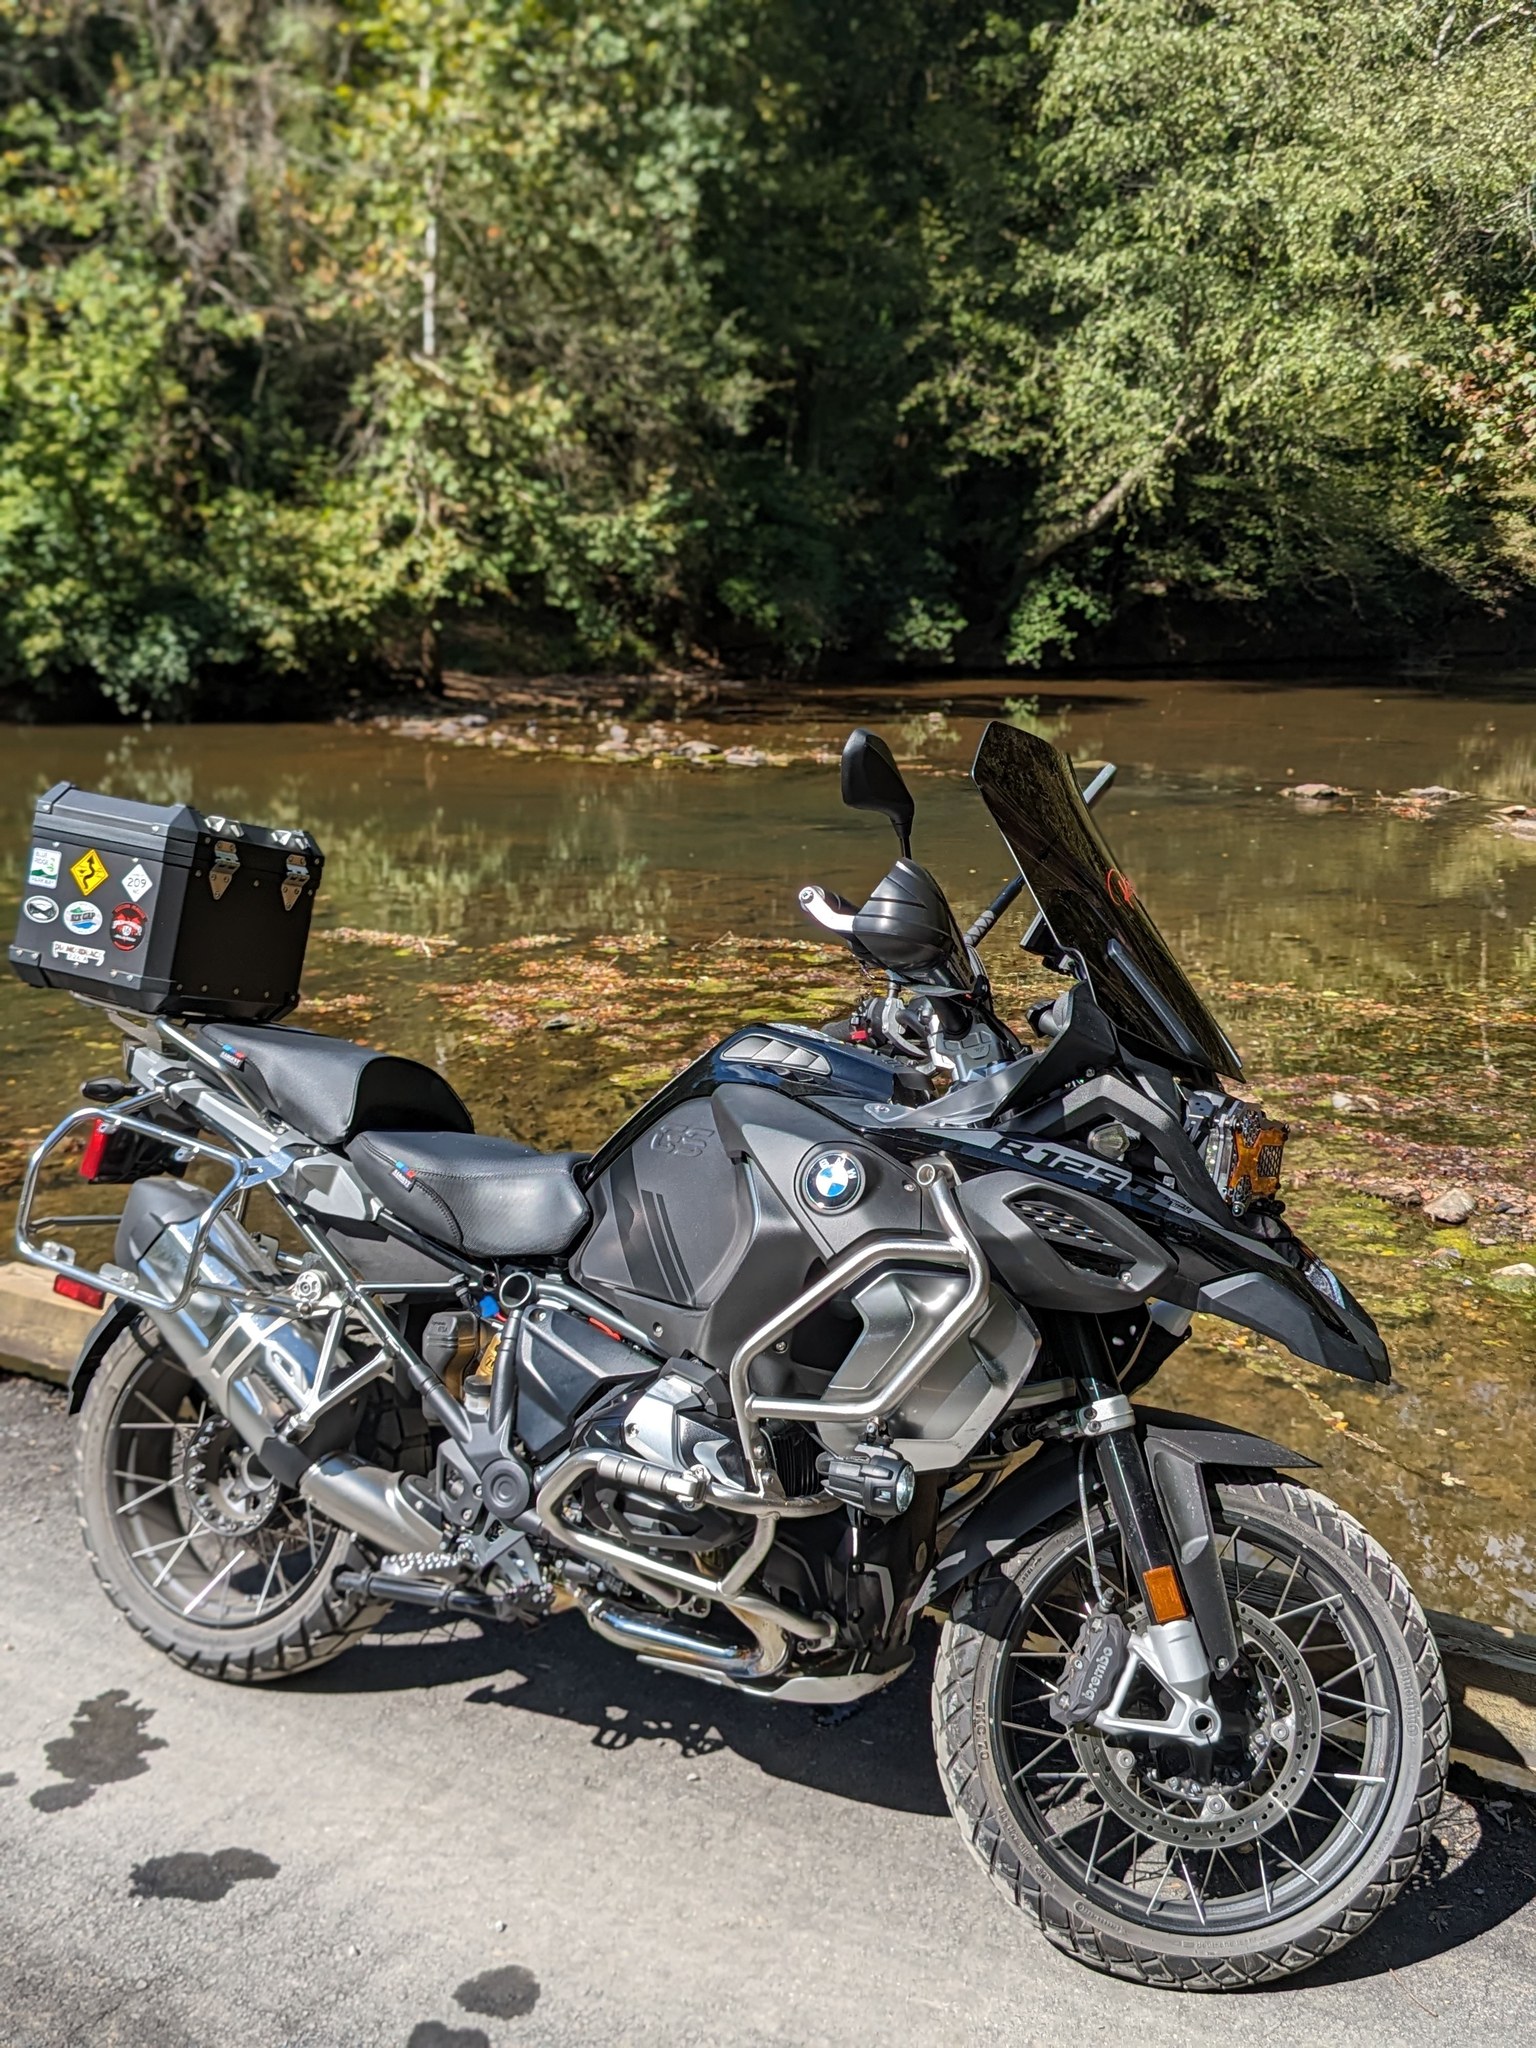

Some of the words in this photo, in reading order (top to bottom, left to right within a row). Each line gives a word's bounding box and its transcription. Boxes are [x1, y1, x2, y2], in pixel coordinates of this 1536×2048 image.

[127, 877, 147, 888] 209
[651, 1123, 715, 1157] GS
[1081, 1646, 1113, 1701] brembo
[974, 1702, 987, 1736] TKC
[976, 1740, 990, 1761] 70
